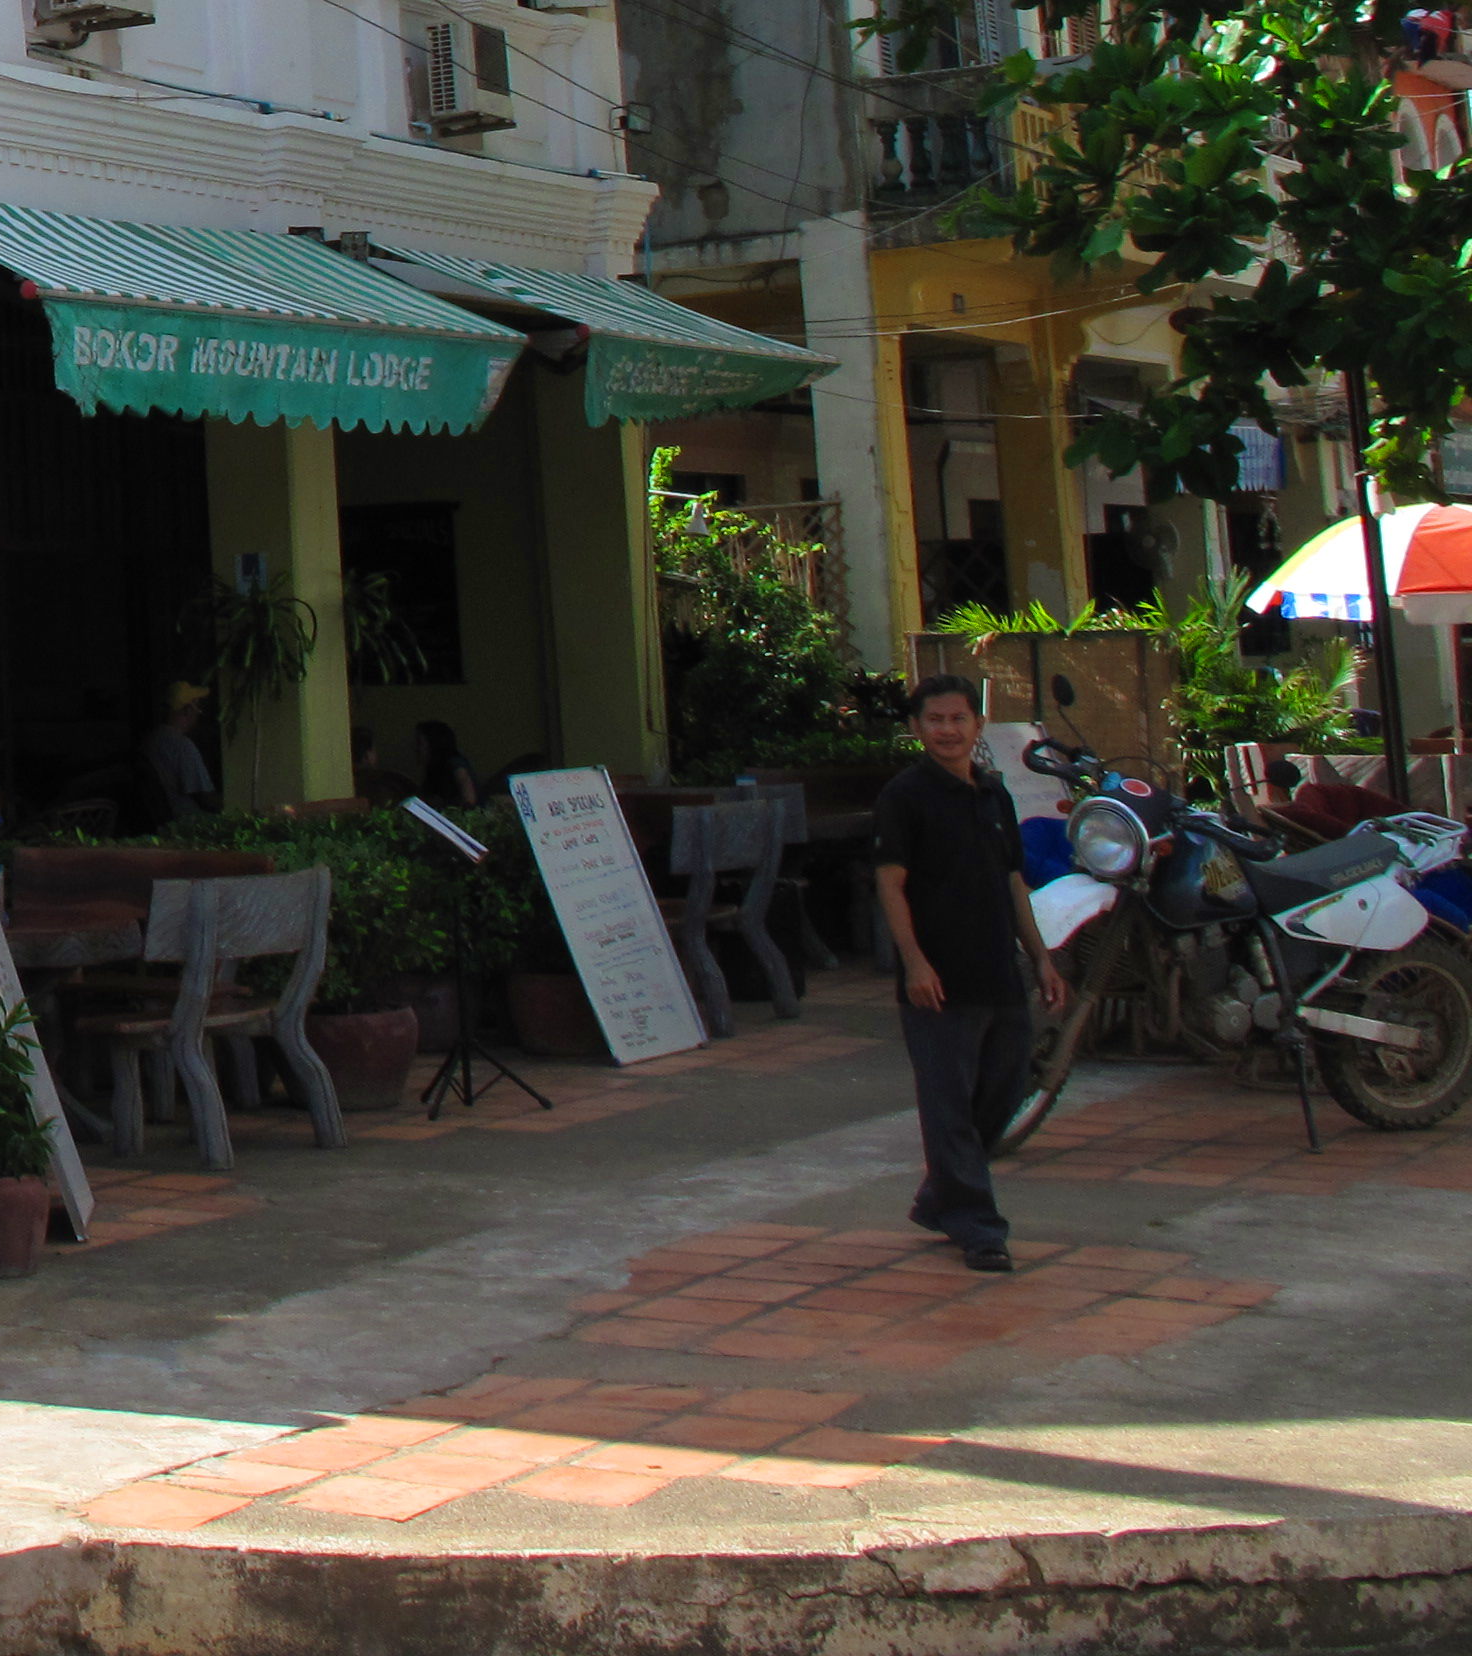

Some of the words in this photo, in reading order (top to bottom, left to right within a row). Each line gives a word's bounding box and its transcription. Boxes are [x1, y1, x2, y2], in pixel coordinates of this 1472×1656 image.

[74, 326, 179, 372] BOKOR
[190, 337, 338, 384] MOUNTAIN
[346, 350, 433, 390] LODGE
